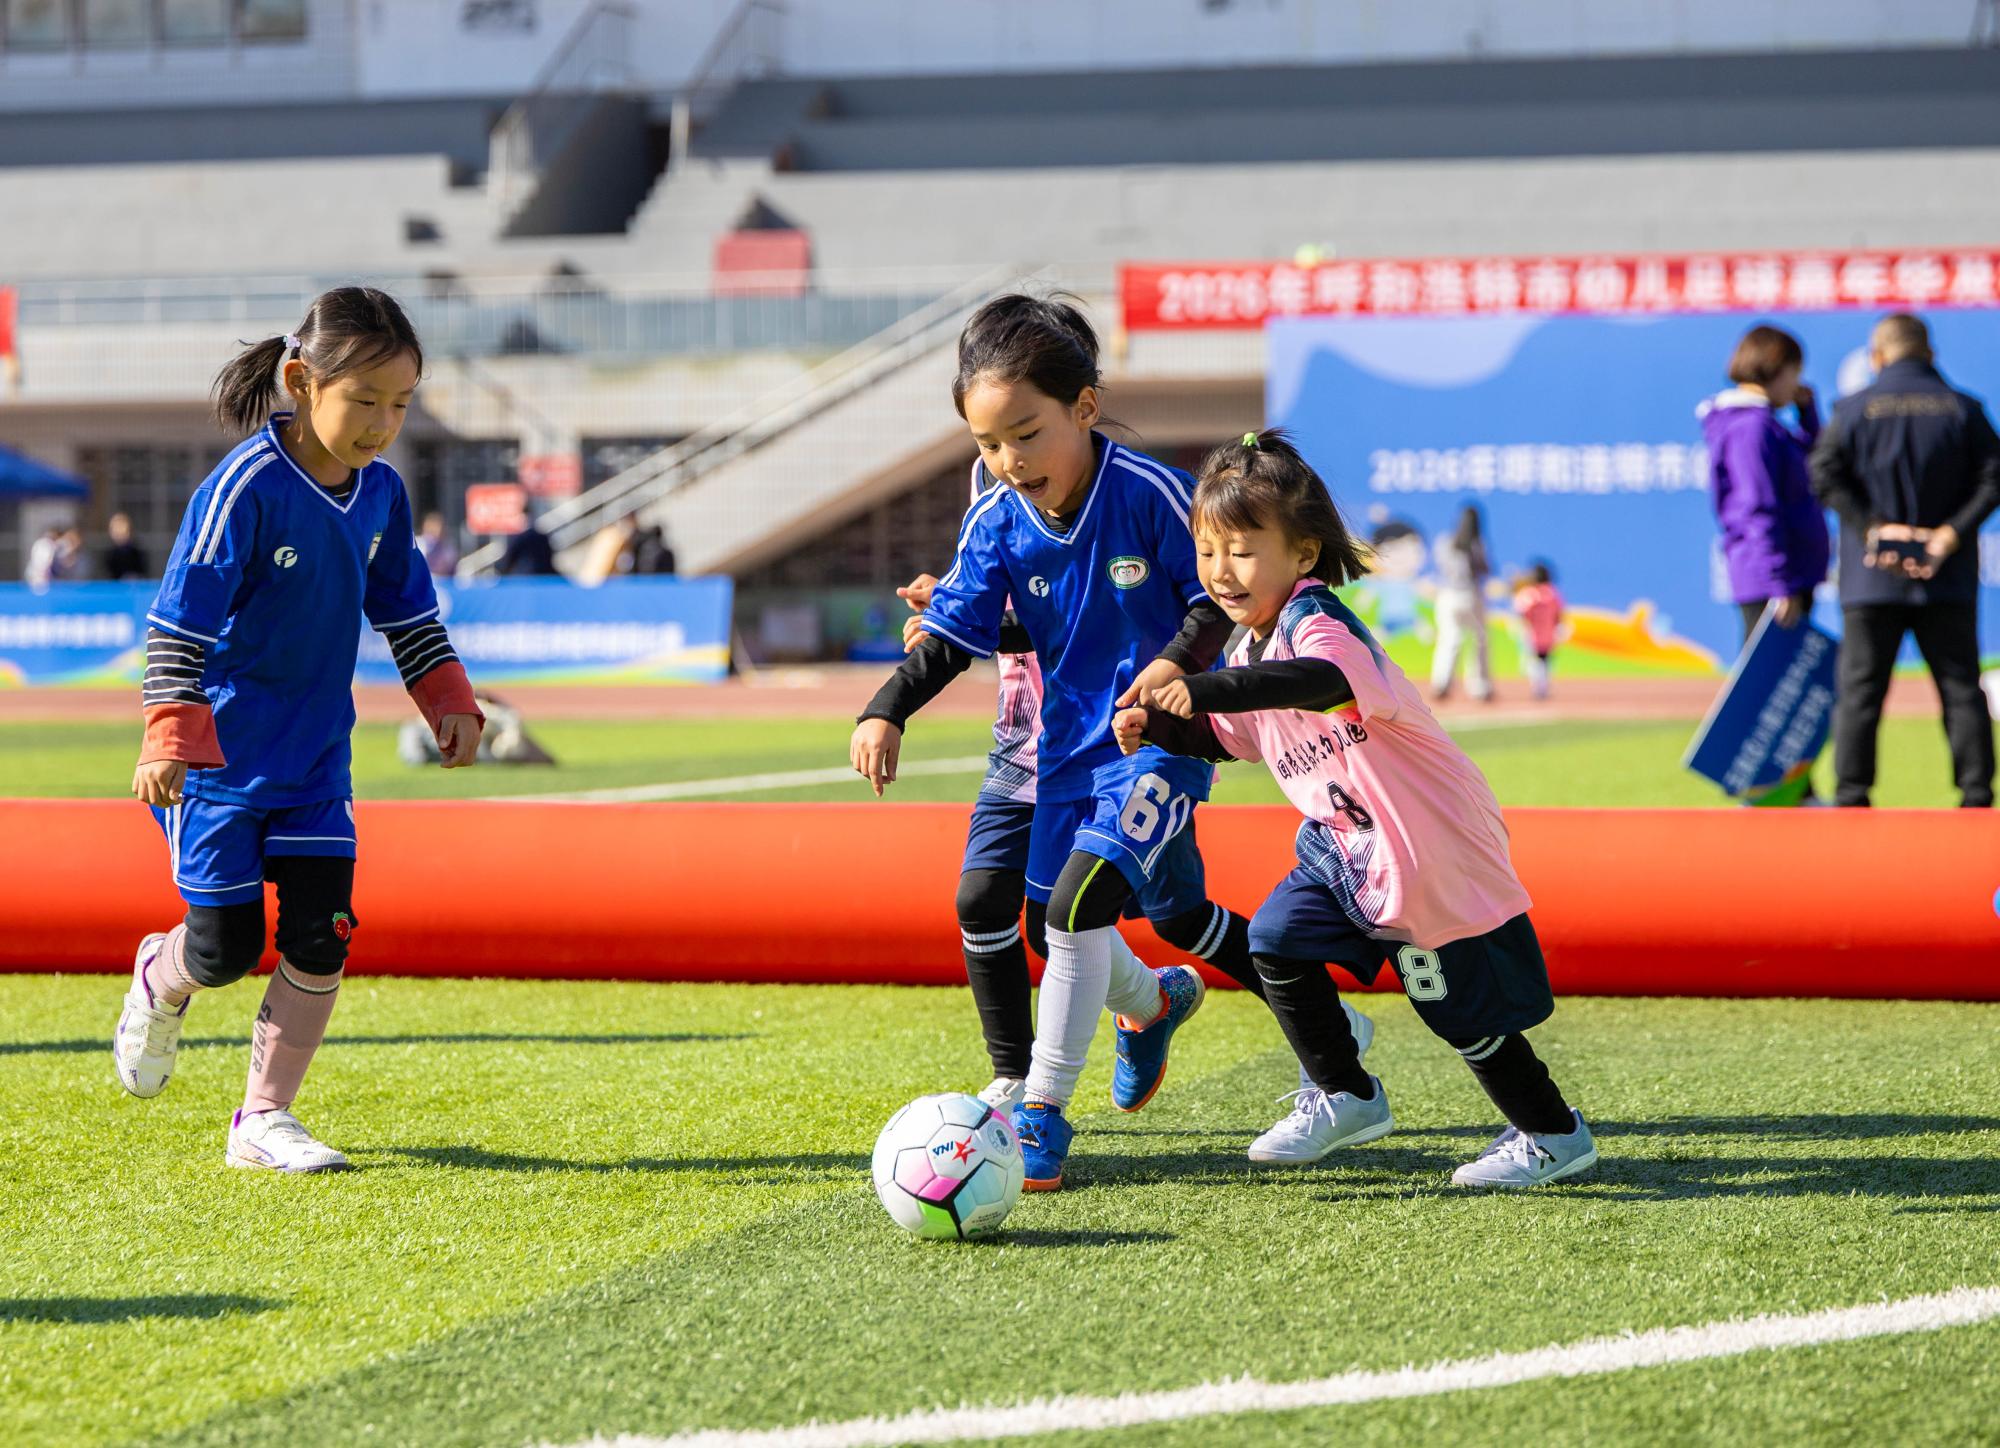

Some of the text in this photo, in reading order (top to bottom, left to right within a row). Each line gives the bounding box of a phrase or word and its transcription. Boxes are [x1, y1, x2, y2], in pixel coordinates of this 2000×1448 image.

[1119, 772, 1171, 843] 6
[1326, 780, 1376, 834] 8
[1396, 944, 1448, 1002] 8
